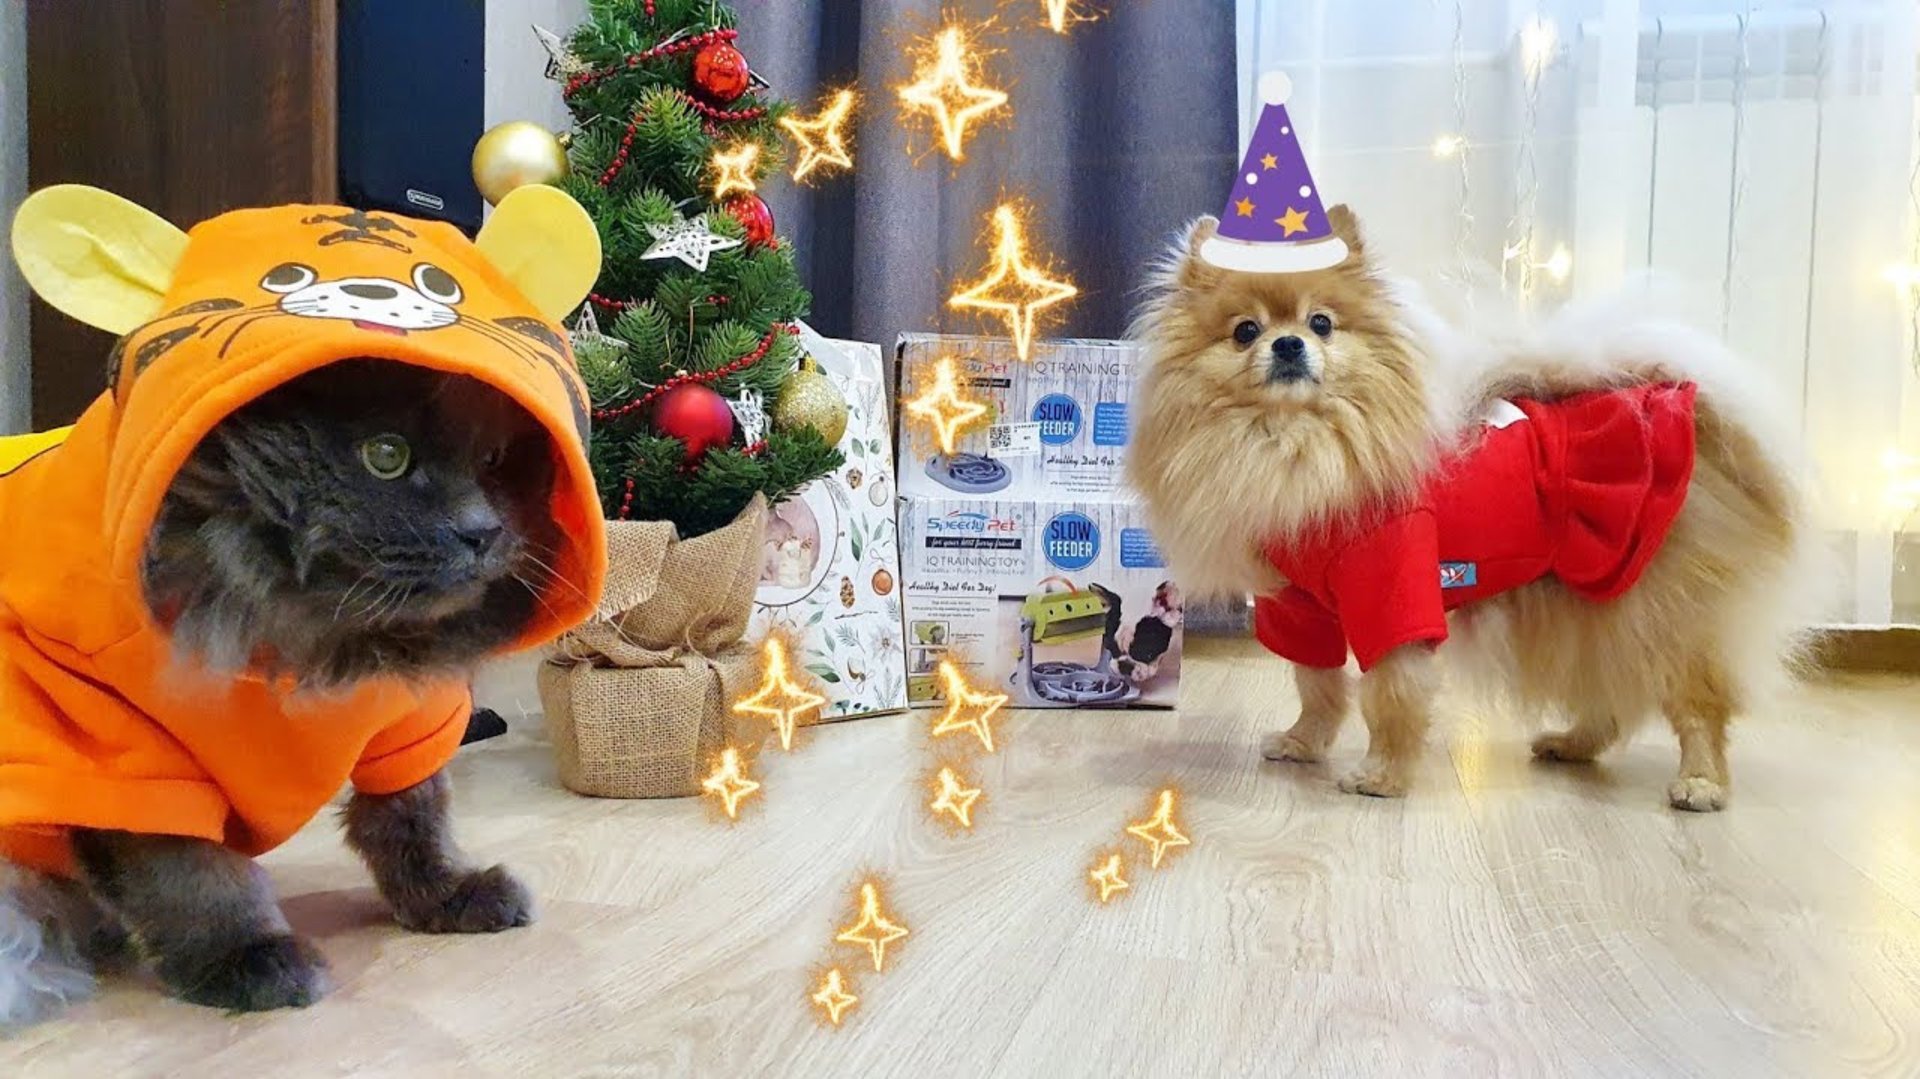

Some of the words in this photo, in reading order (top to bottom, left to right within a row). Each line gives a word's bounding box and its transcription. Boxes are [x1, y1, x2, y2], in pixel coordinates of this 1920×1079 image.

[984, 362, 1008, 373] Pet
[1031, 361, 1047, 374] IQ
[1048, 361, 1120, 375] TRAINING
[1039, 402, 1075, 421] SLOW
[1046, 454, 1078, 468] Healthy
[926, 517, 985, 533] Speedy
[987, 519, 1016, 531] Pet
[1050, 519, 1092, 541] SLOW
[1049, 541, 1093, 557] FEEDER
[926, 556, 939, 567] IQ
[940, 556, 997, 567] TRAINING
[908, 581, 940, 593] Healthy
